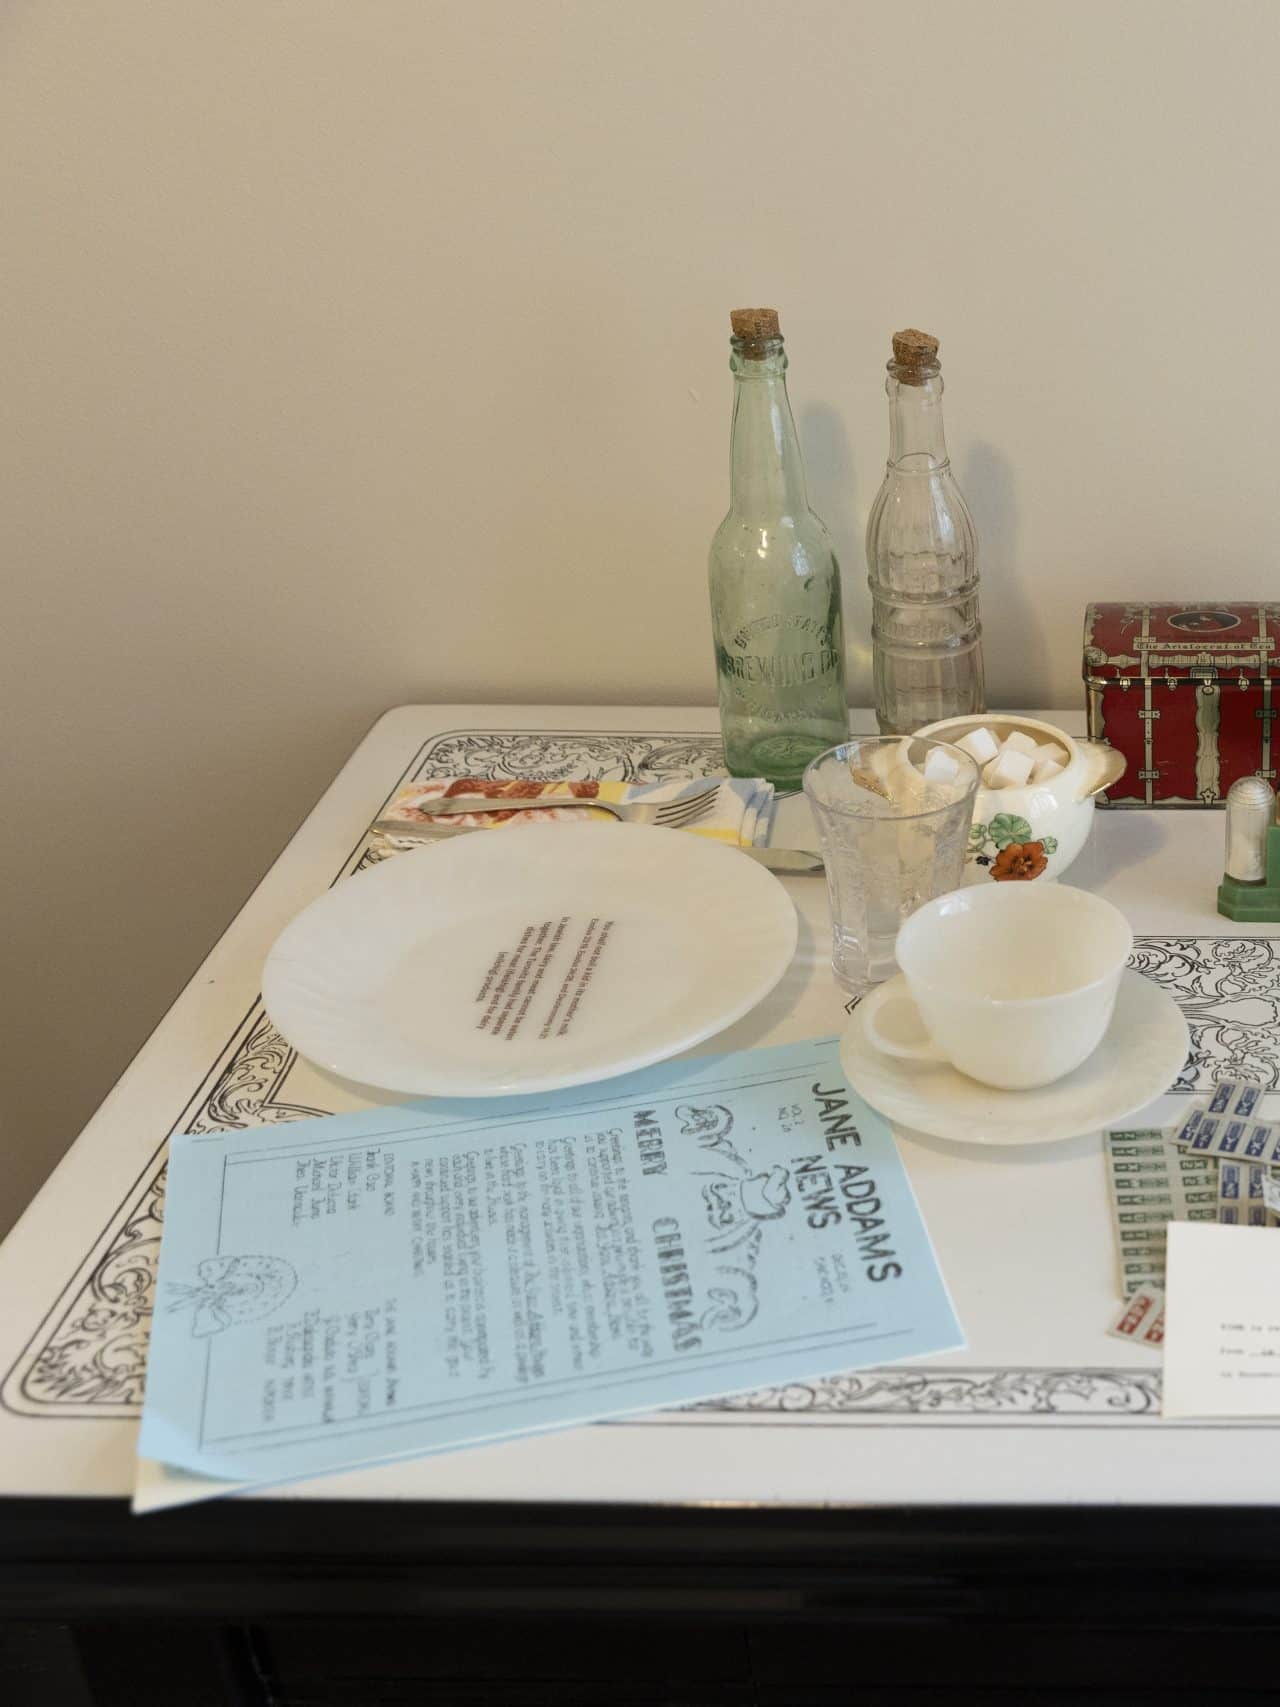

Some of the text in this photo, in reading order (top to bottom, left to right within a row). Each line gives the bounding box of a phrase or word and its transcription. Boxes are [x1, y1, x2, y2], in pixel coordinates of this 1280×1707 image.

[1161, 642, 1227, 650] Aristocrat
[812, 1083, 861, 1150] JANE
[792, 1155, 841, 1229] NEWS
[836, 1165, 902, 1282] ADDAMS
[634, 1110, 701, 1349] MERRY CHRISTMAS
